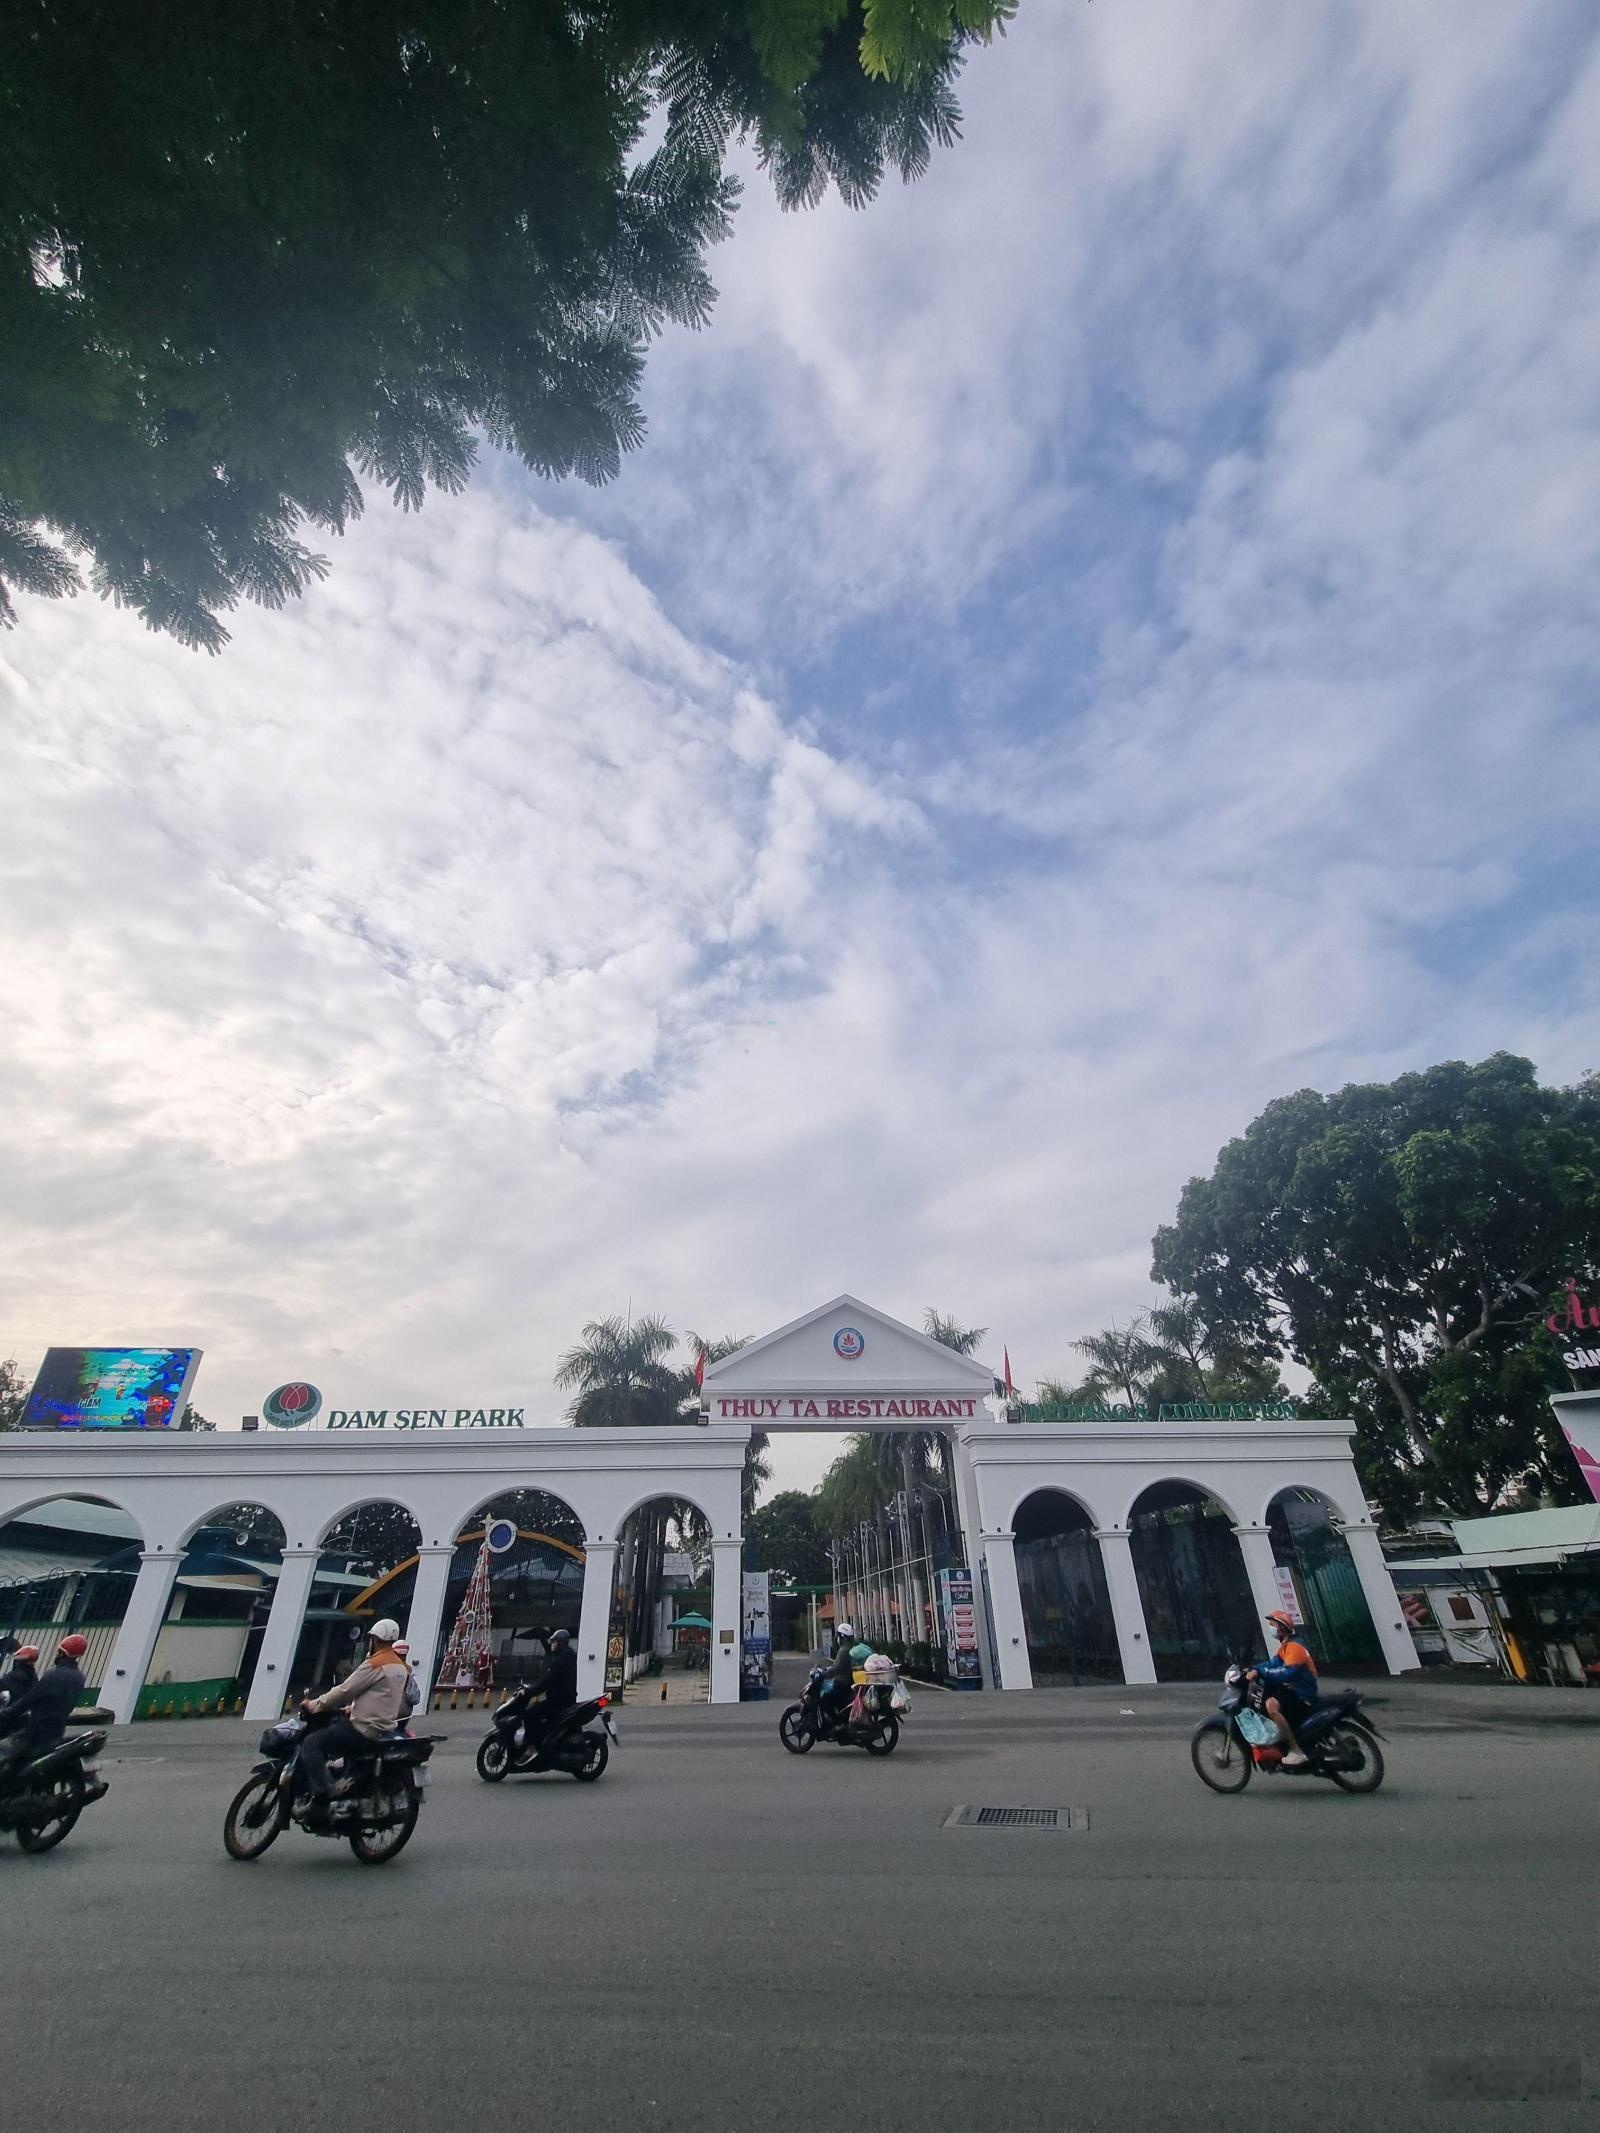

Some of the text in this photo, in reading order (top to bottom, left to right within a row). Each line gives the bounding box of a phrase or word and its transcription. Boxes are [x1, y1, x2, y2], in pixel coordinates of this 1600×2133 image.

[717, 1398, 977, 1418] THUY TA RESTAURANT
[326, 1408, 525, 1430] DAM SEN PARK
